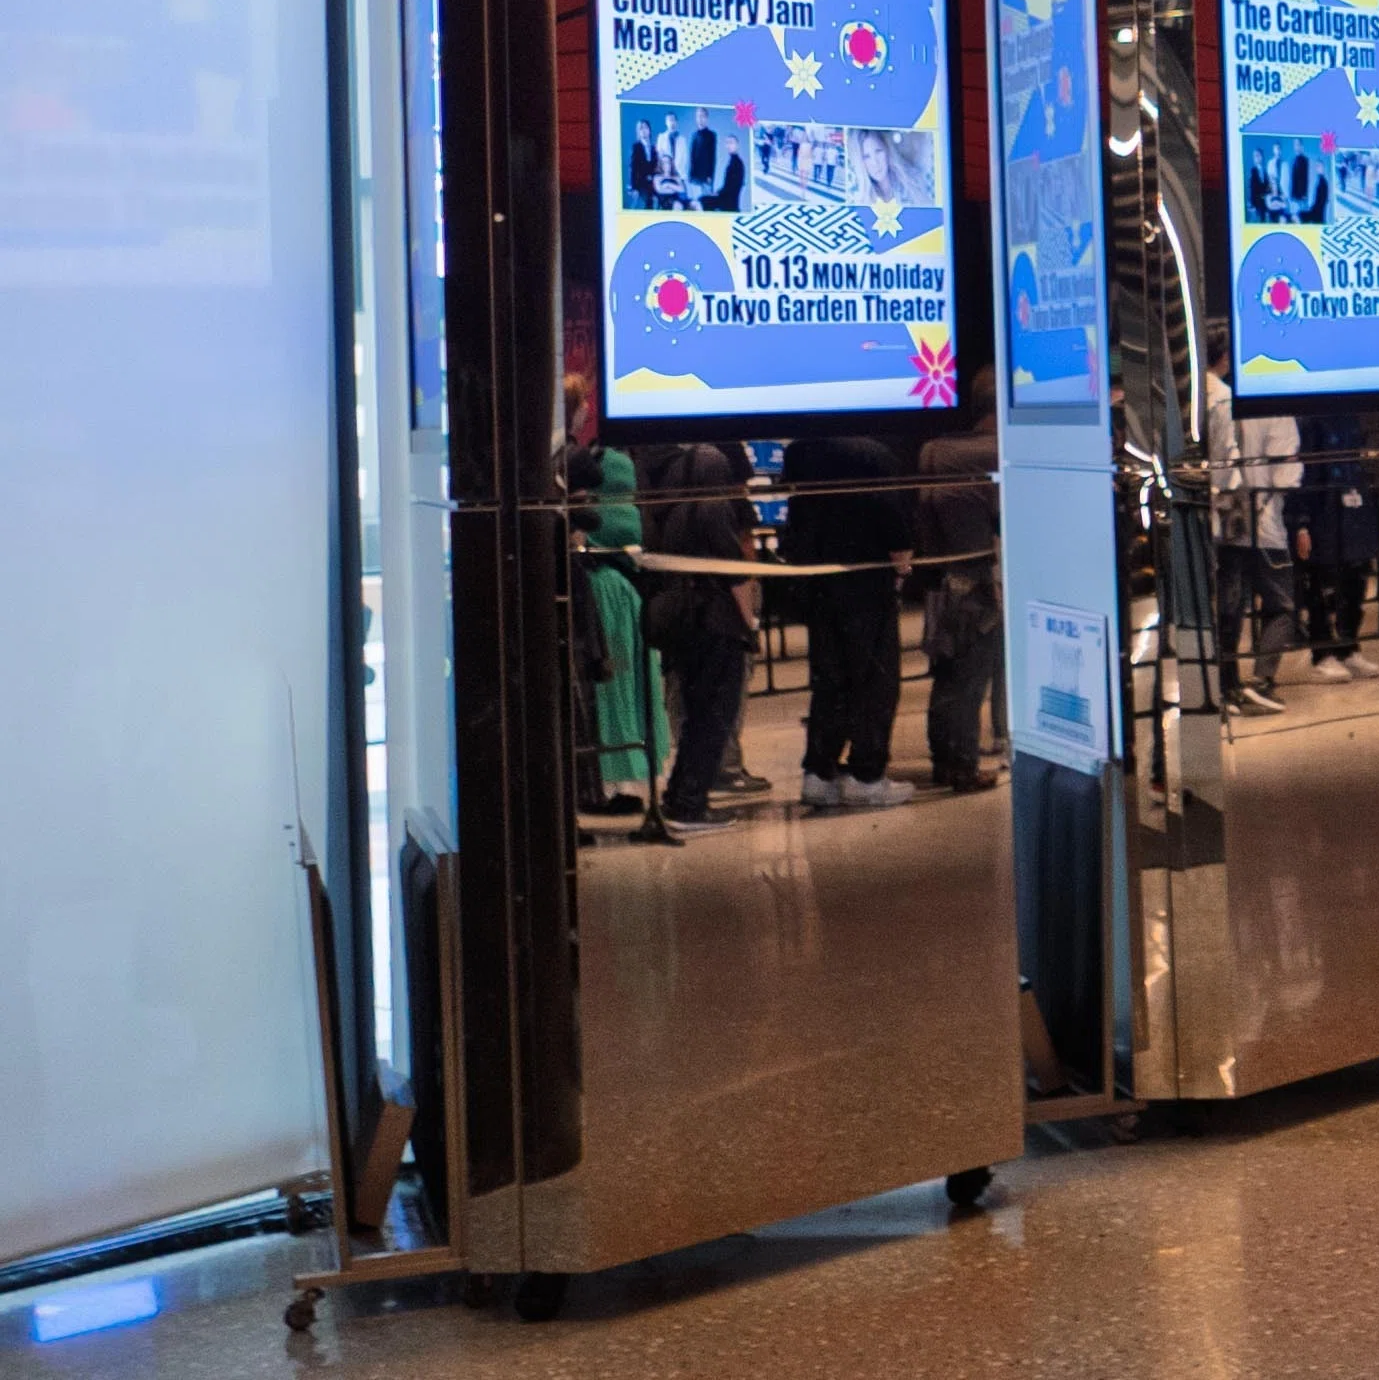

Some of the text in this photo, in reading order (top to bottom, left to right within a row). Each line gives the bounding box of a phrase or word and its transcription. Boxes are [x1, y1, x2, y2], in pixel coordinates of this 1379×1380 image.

[613, 18, 678, 55] Meja
[1235, 33, 1375, 69] Cloudberry Jam
[1236, 64, 1282, 95] Meja
[741, 254, 810, 290] 10.13
[1327, 259, 1374, 289] 10.13
[702, 293, 946, 326] Tokyo Garden Theater
[1301, 293, 1349, 319] Tokyo
